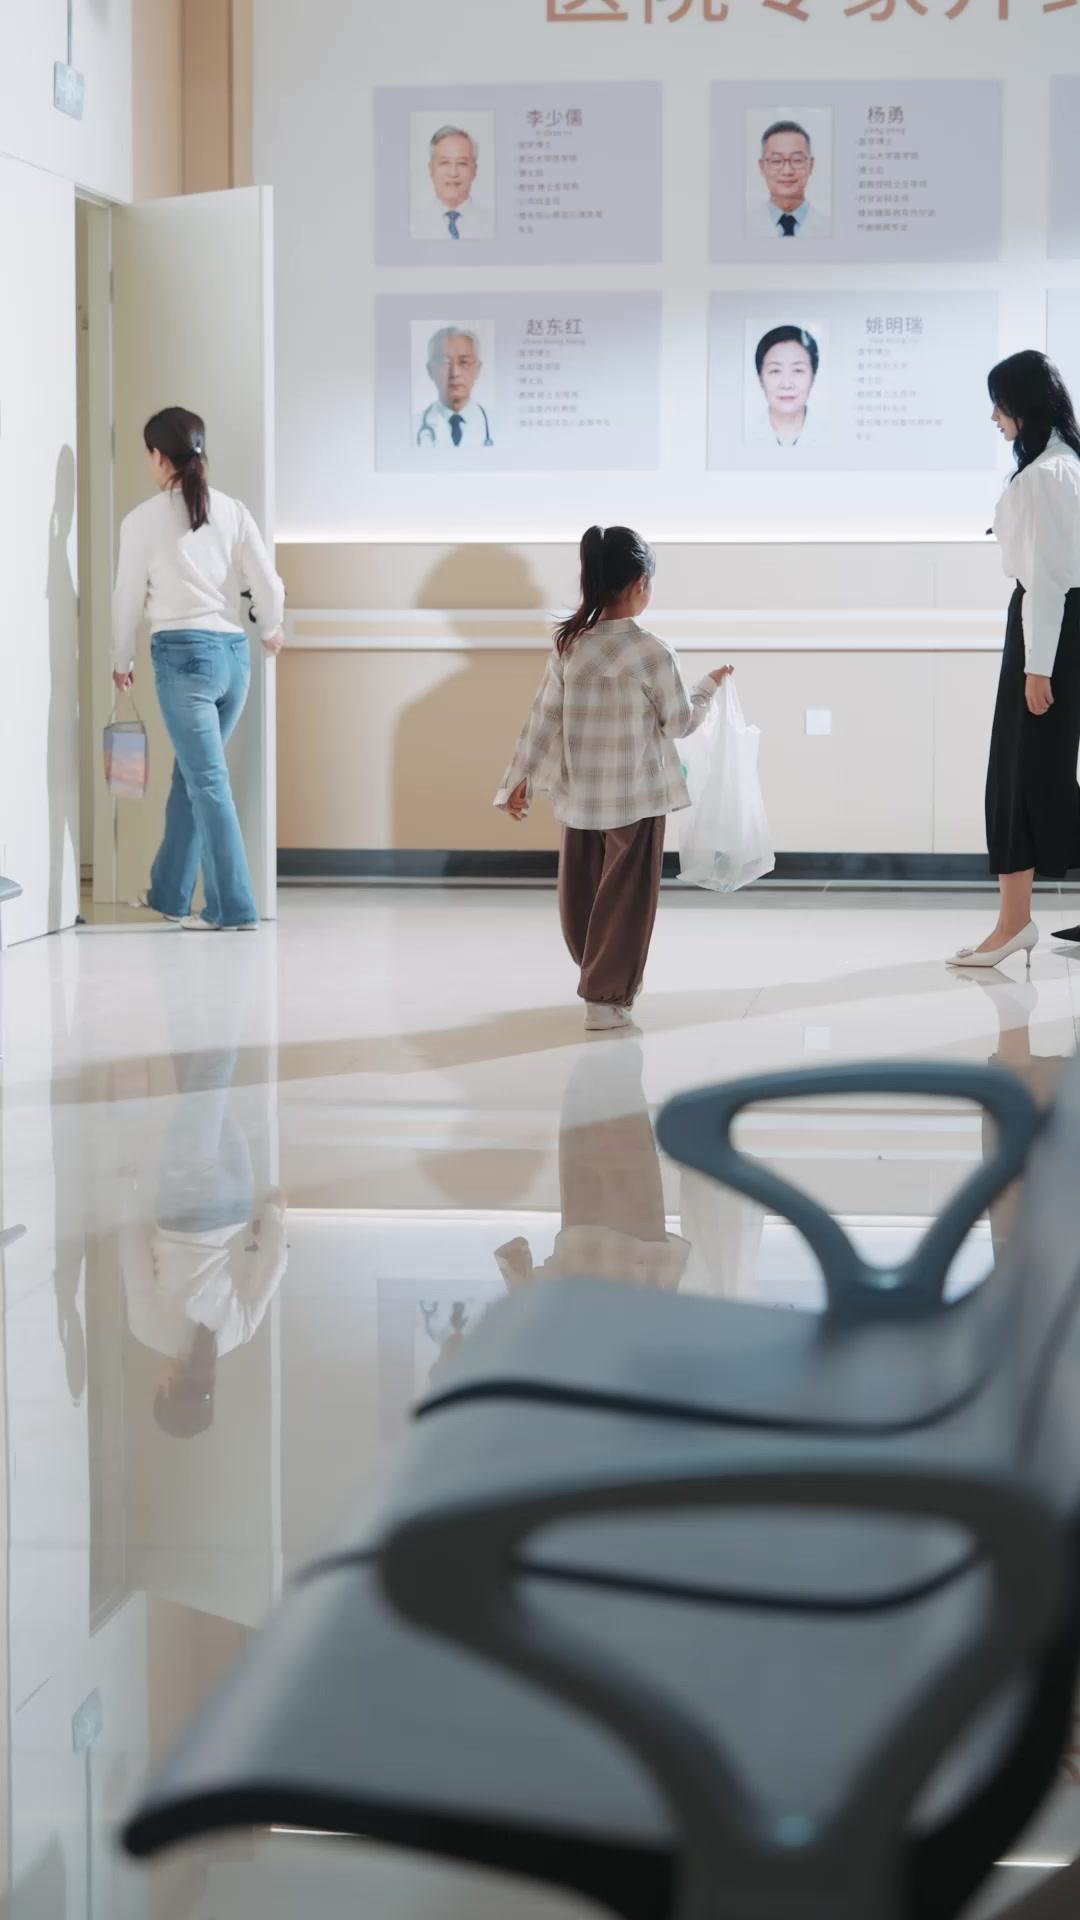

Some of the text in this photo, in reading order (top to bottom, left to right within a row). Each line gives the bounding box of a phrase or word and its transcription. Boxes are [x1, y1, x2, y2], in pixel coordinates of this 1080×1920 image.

[526, 108, 582, 128] 李少儒
[867, 105, 904, 124] 杨勇
[526, 317, 583, 336] 赵东红
[865, 316, 923, 335] 姚明瑞
